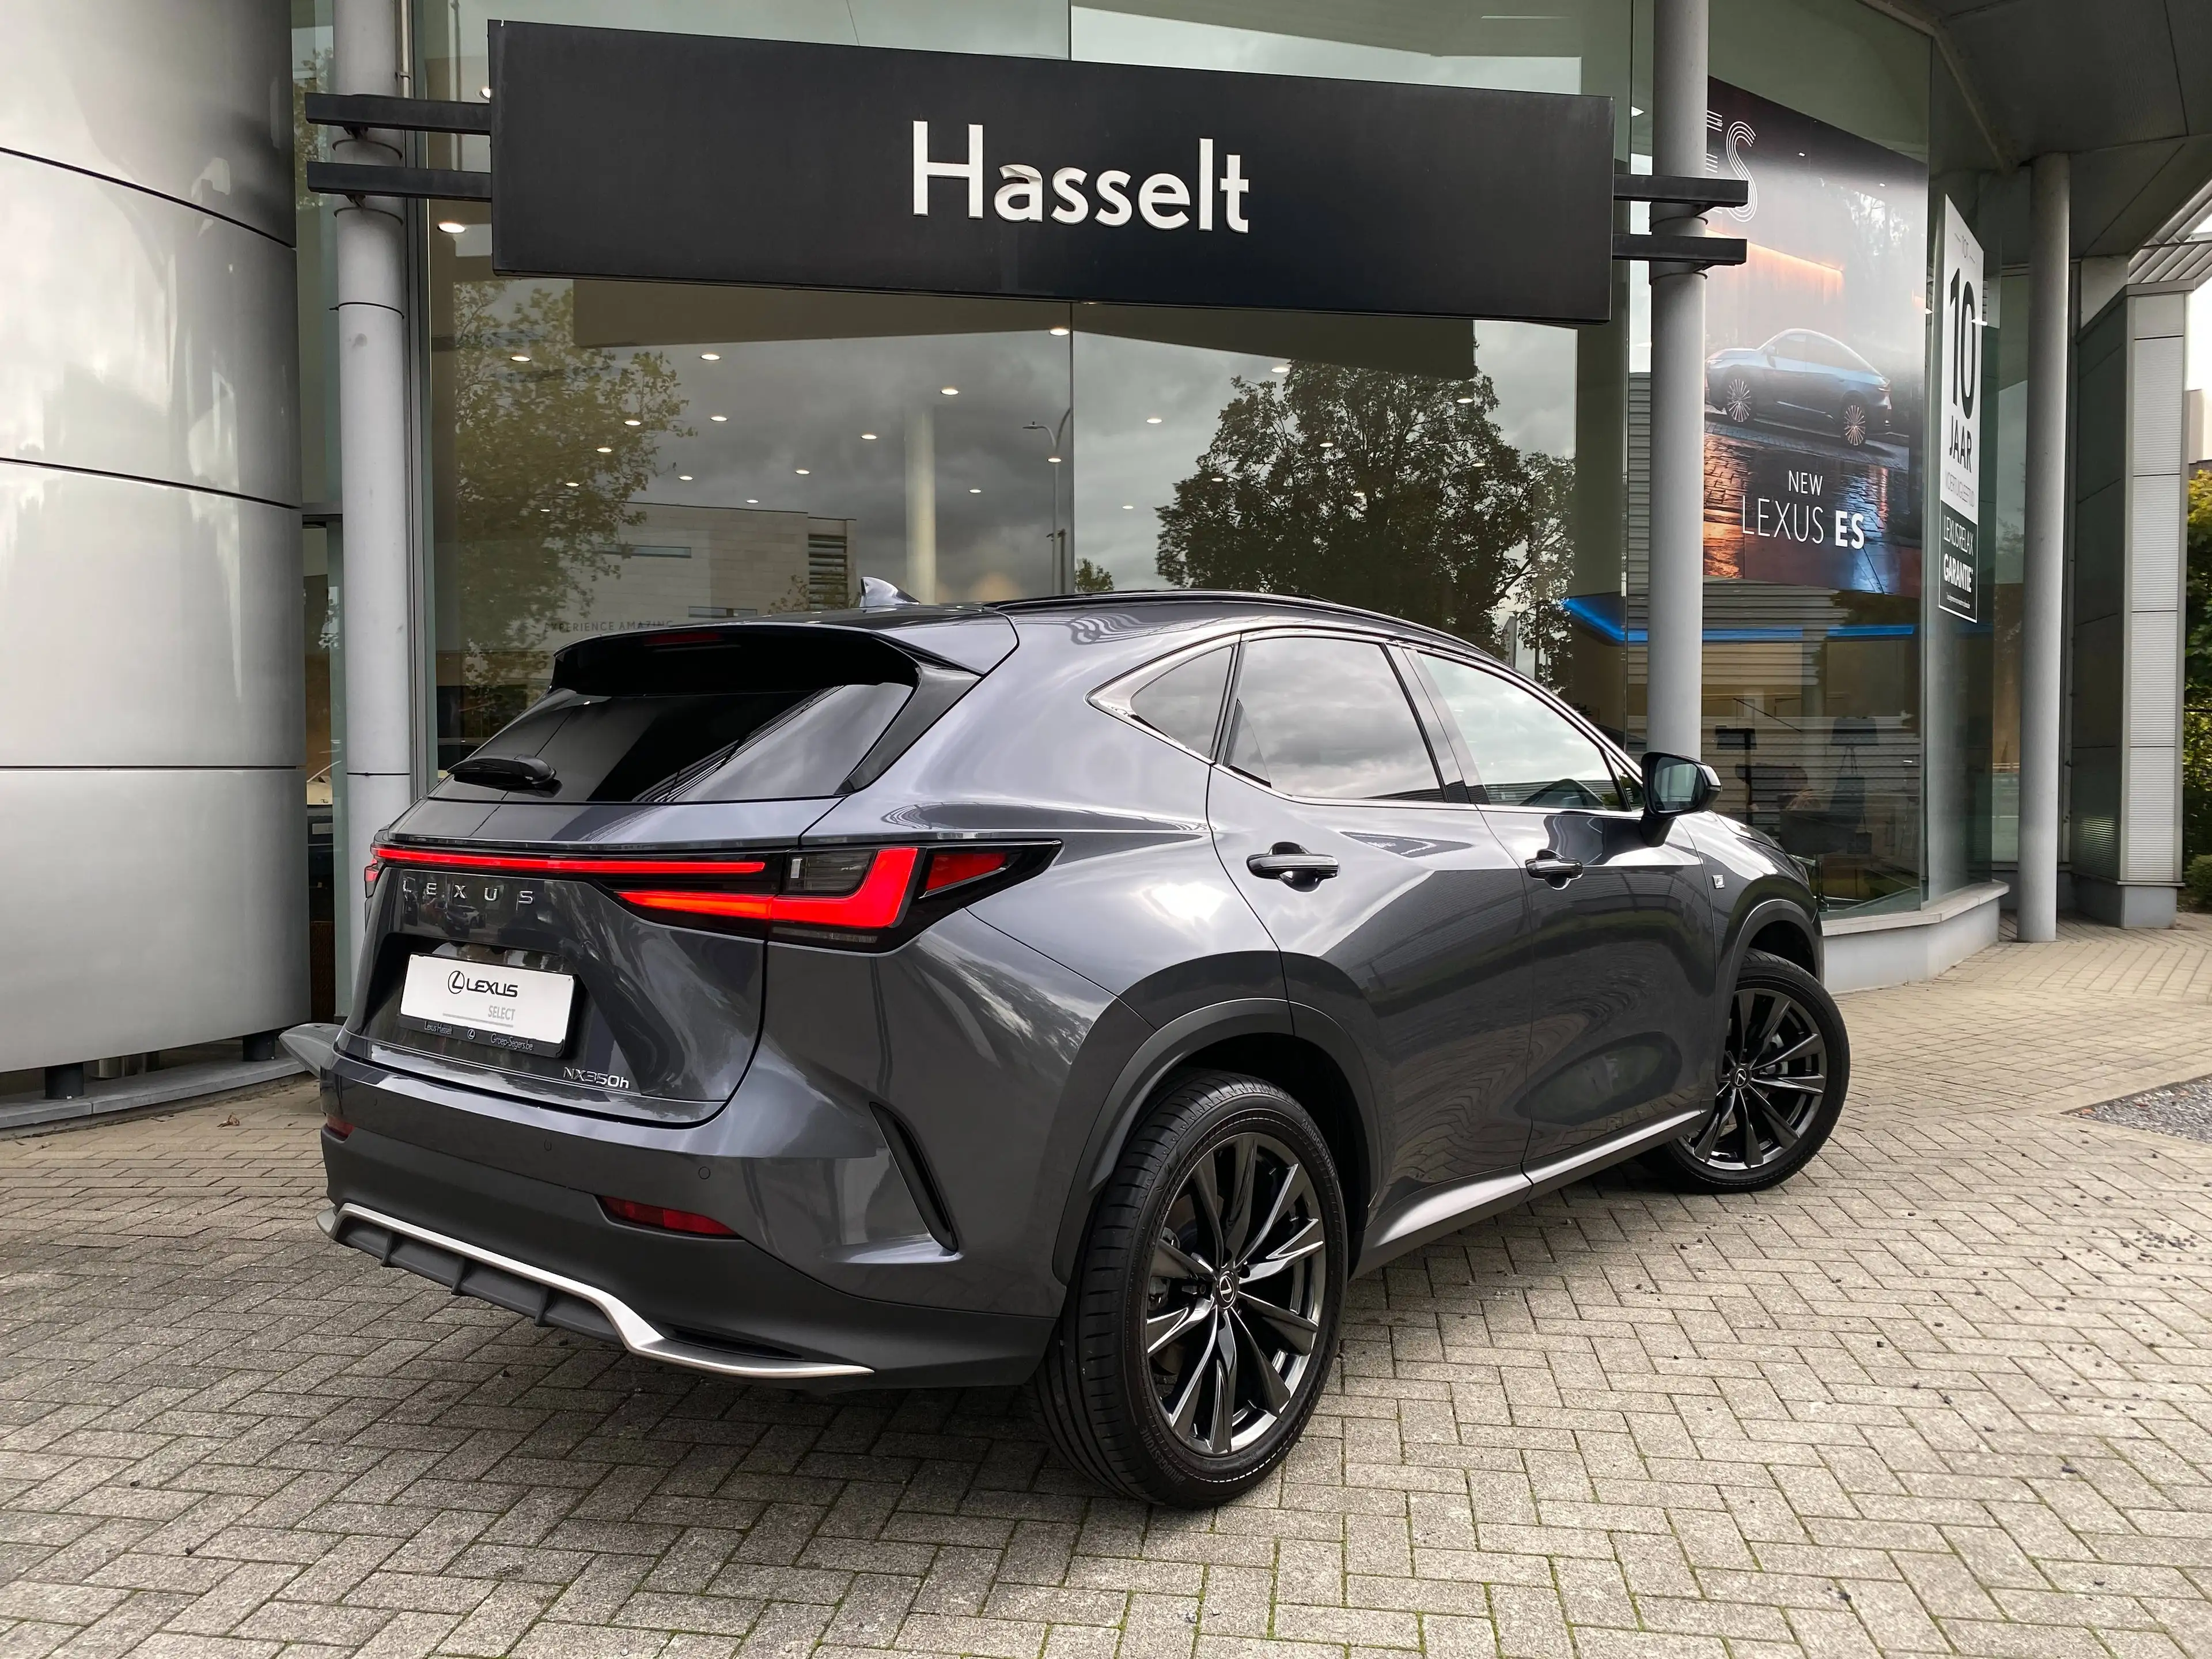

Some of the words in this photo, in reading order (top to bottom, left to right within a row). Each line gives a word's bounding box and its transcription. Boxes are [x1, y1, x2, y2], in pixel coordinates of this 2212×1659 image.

[912, 120, 1249, 233] Hasselt
[1950, 267, 1976, 419] 10
[1949, 415, 1972, 473] JAAR
[1789, 469, 1823, 496] NEW
[1742, 495, 1824, 544] LEXUS
[1835, 510, 1865, 550] ES
[544, 621, 614, 632] EXPERIENCE
[403, 879, 533, 905] LEXUS
[466, 978, 518, 998] LEXUS
[487, 1005, 516, 1021] SELECT
[424, 1020, 437, 1032] Lexus
[490, 1033, 533, 1051] Groep-Segers.be
[563, 1066, 630, 1089] NX350h
